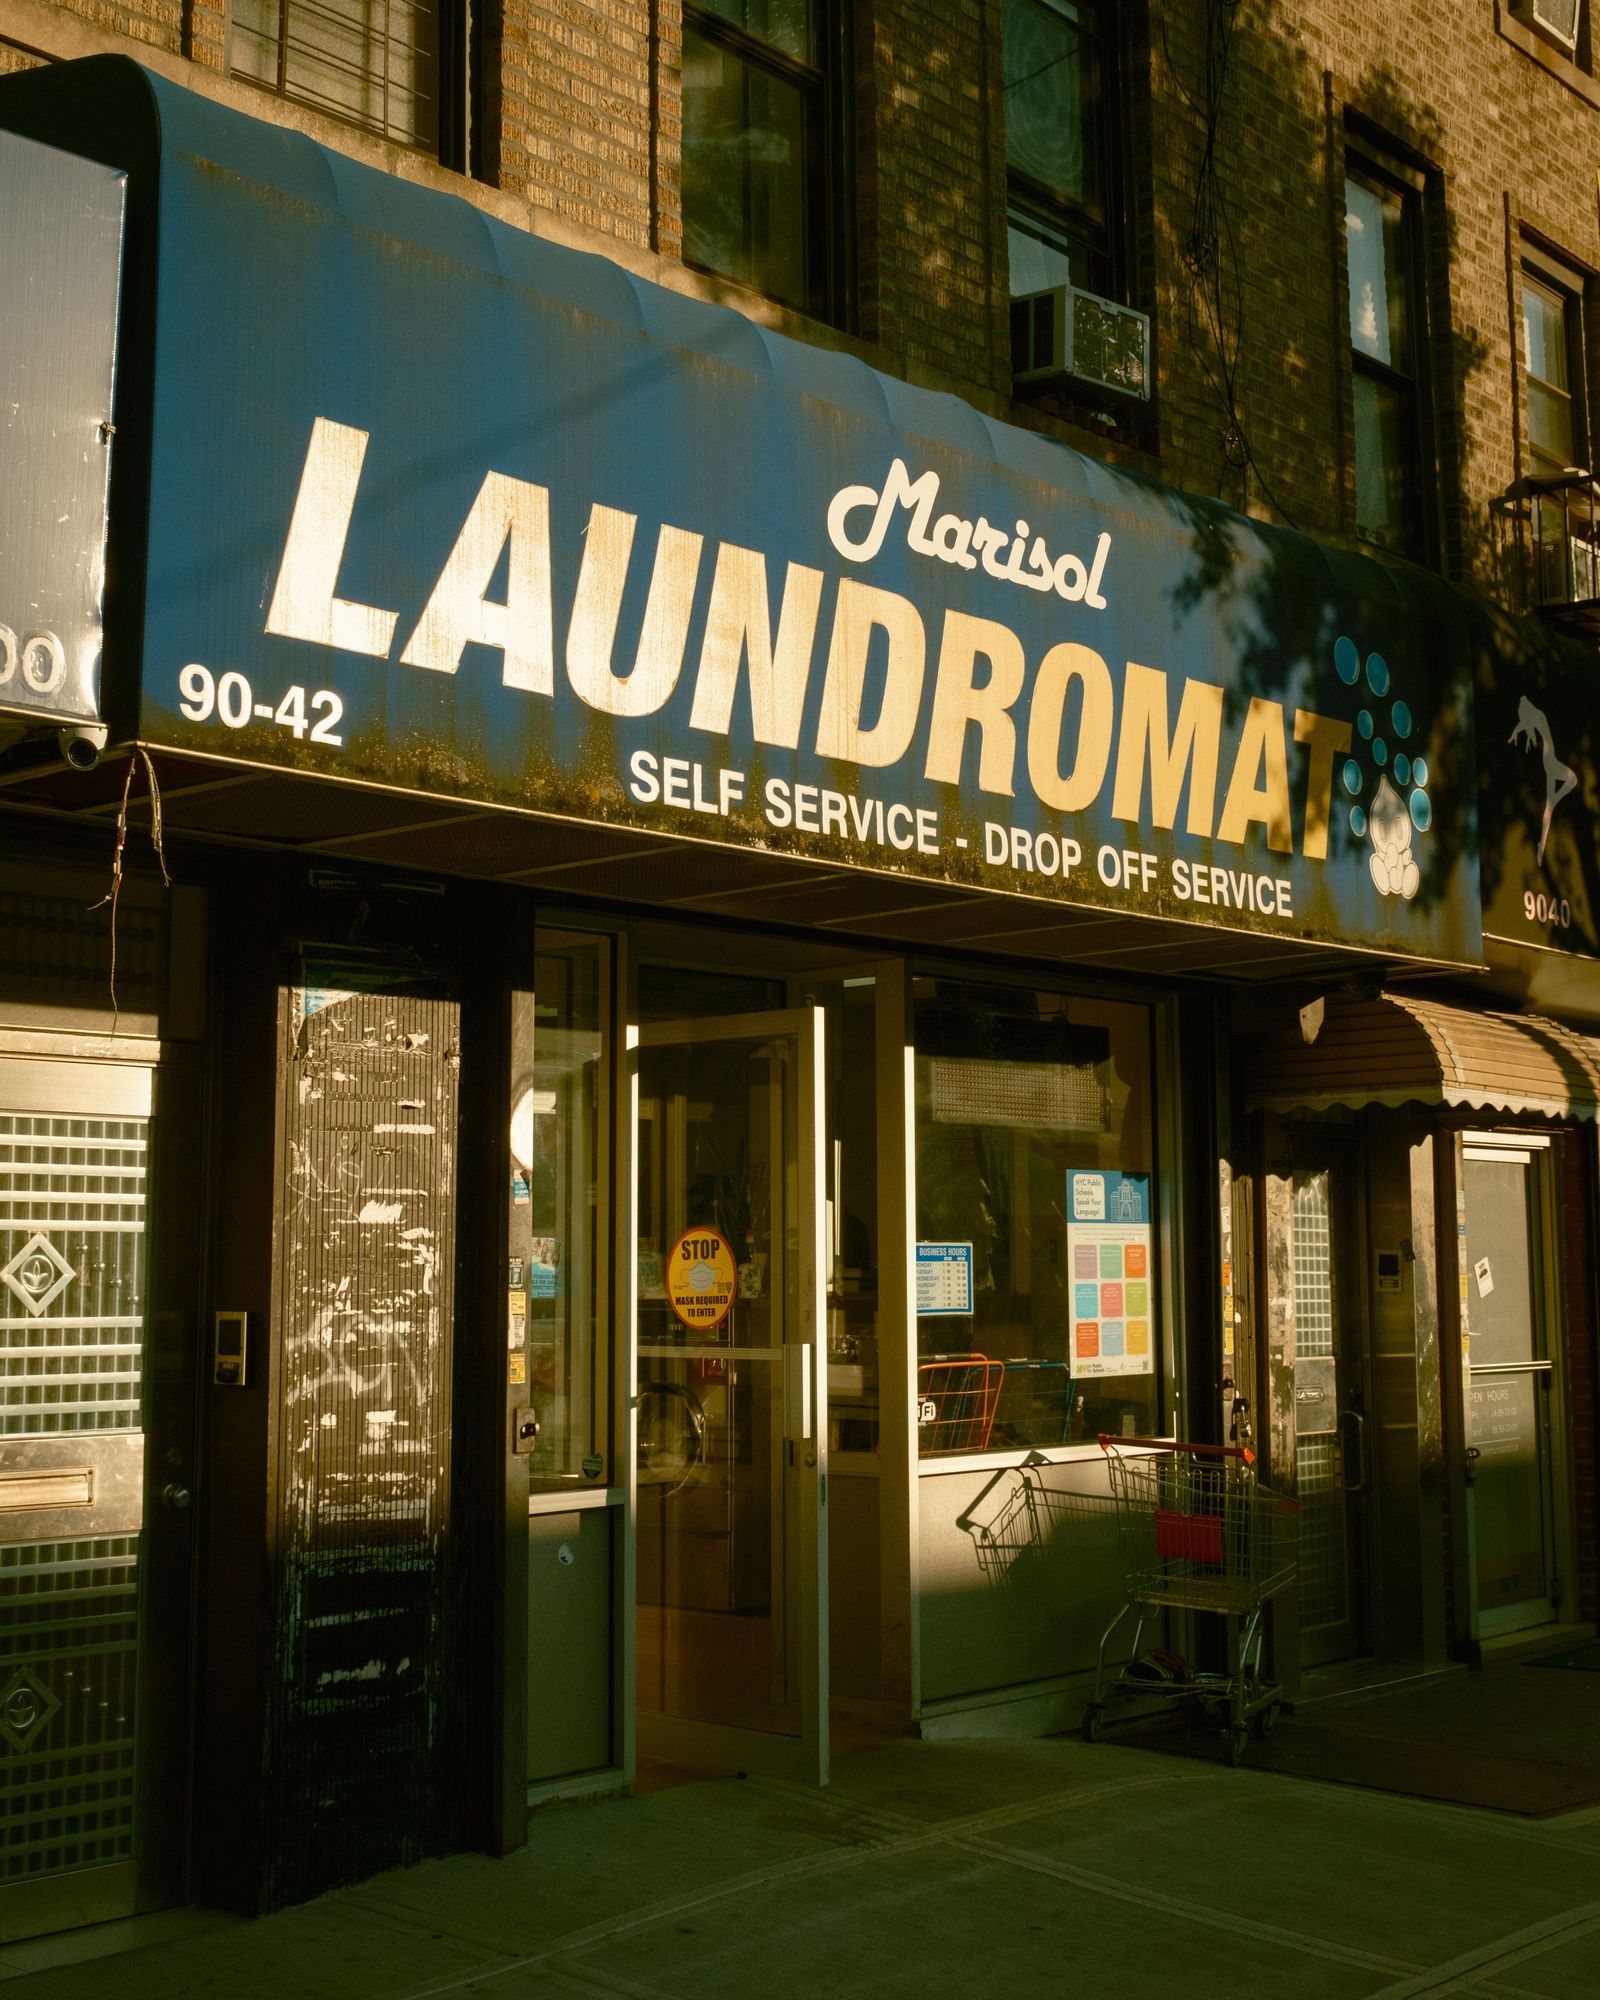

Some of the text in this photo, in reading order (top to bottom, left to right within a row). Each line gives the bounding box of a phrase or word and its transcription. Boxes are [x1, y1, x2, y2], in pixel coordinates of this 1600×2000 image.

[827, 458, 1112, 610] Marisol
[265, 416, 1352, 860] LAUNDROMAT
[179, 663, 344, 747] 90-42
[630, 750, 745, 816] SELF
[764, 778, 940, 856] SERVICE
[985, 822, 1082, 878] DROP
[1097, 844, 1158, 893] OFF
[1172, 858, 1294, 918] SERVICE
[1523, 890, 1570, 929] 9040
[1087, 1179, 1102, 1187] Public
[1076, 1187, 1094, 1196] Schools
[1076, 1198, 1102, 1207] Speak Your
[1076, 1208, 1100, 1217] Language!
[681, 1238, 720, 1261] STOP
[919, 1247, 967, 1256] BUSINESS HOURS
[675, 1295, 729, 1306] MASK REQUIRED
[687, 1308, 716, 1317] TO ENTER
[1486, 1389, 1509, 1402] HOURS
